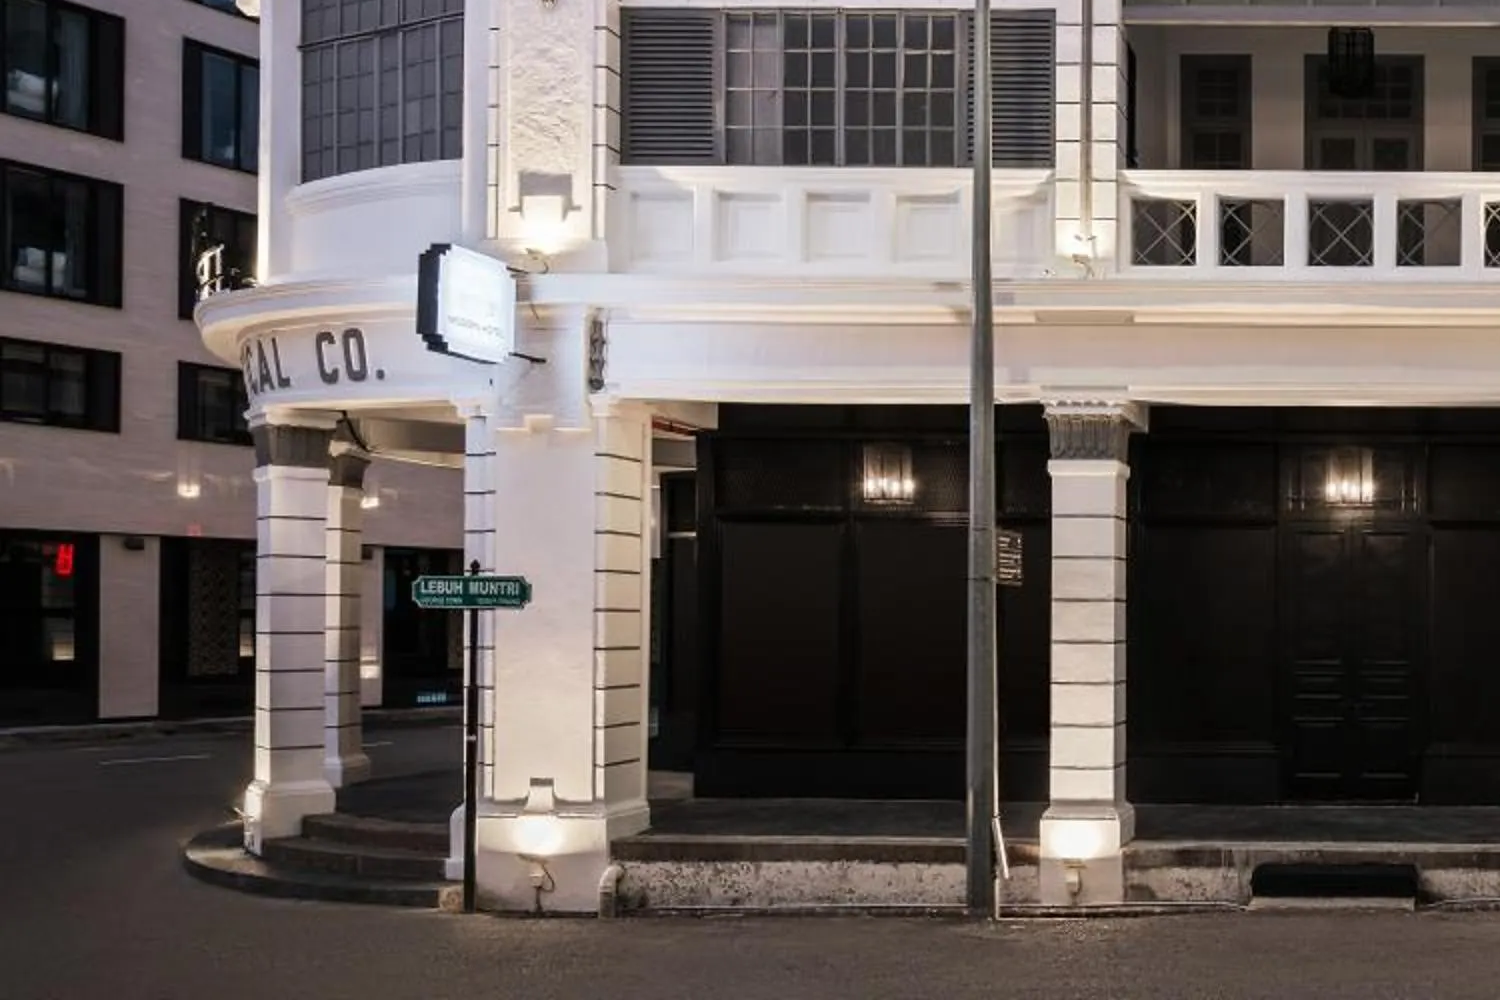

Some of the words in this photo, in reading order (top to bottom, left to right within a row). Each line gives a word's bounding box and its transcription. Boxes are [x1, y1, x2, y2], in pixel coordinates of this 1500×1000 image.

[315, 327, 386, 385] CO.
[420, 580, 462, 594] LEBUH
[469, 580, 519, 595] MUNTRI
